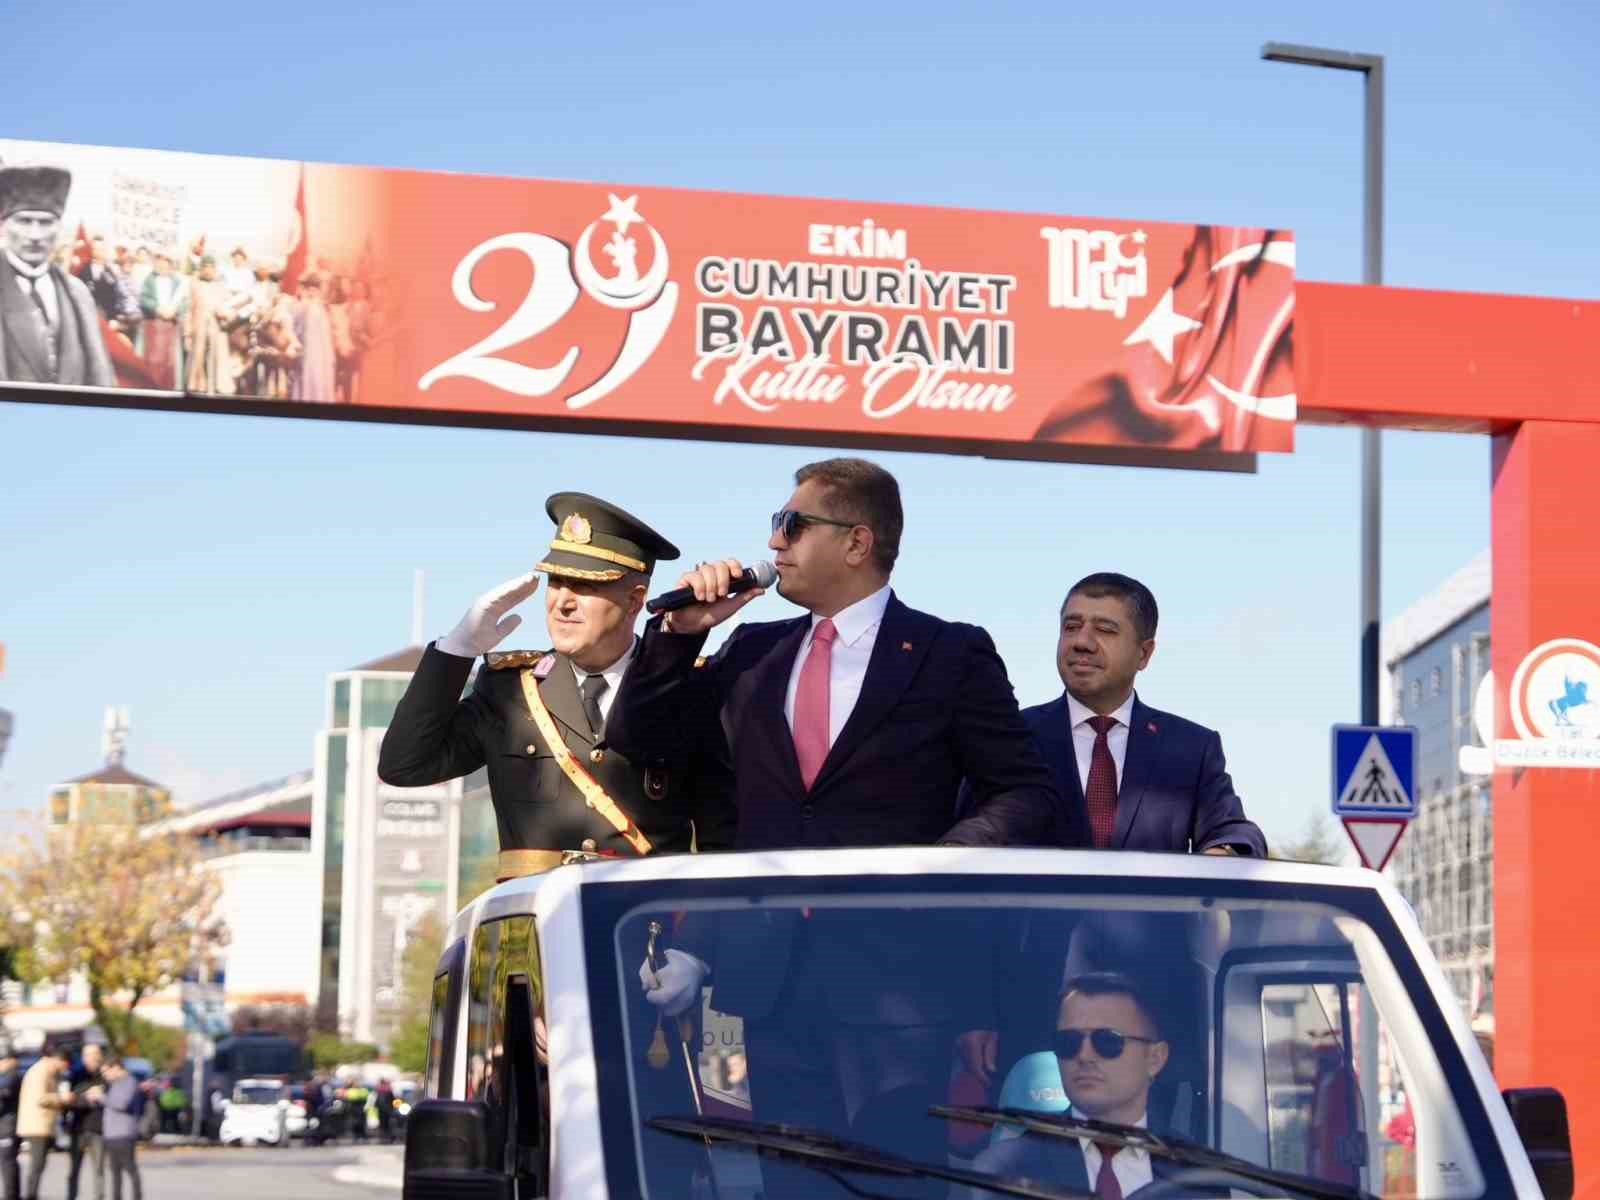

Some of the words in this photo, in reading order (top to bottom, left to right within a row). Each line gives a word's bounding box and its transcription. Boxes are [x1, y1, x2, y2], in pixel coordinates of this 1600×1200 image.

[808, 218, 907, 260] EKİM
[418, 205, 680, 410] 29
[697, 257, 1014, 314] CUMHURİYET
[697, 304, 1014, 374] BAYRAMI
[691, 343, 847, 413] Kutlu
[862, 351, 1017, 419] Olsun
